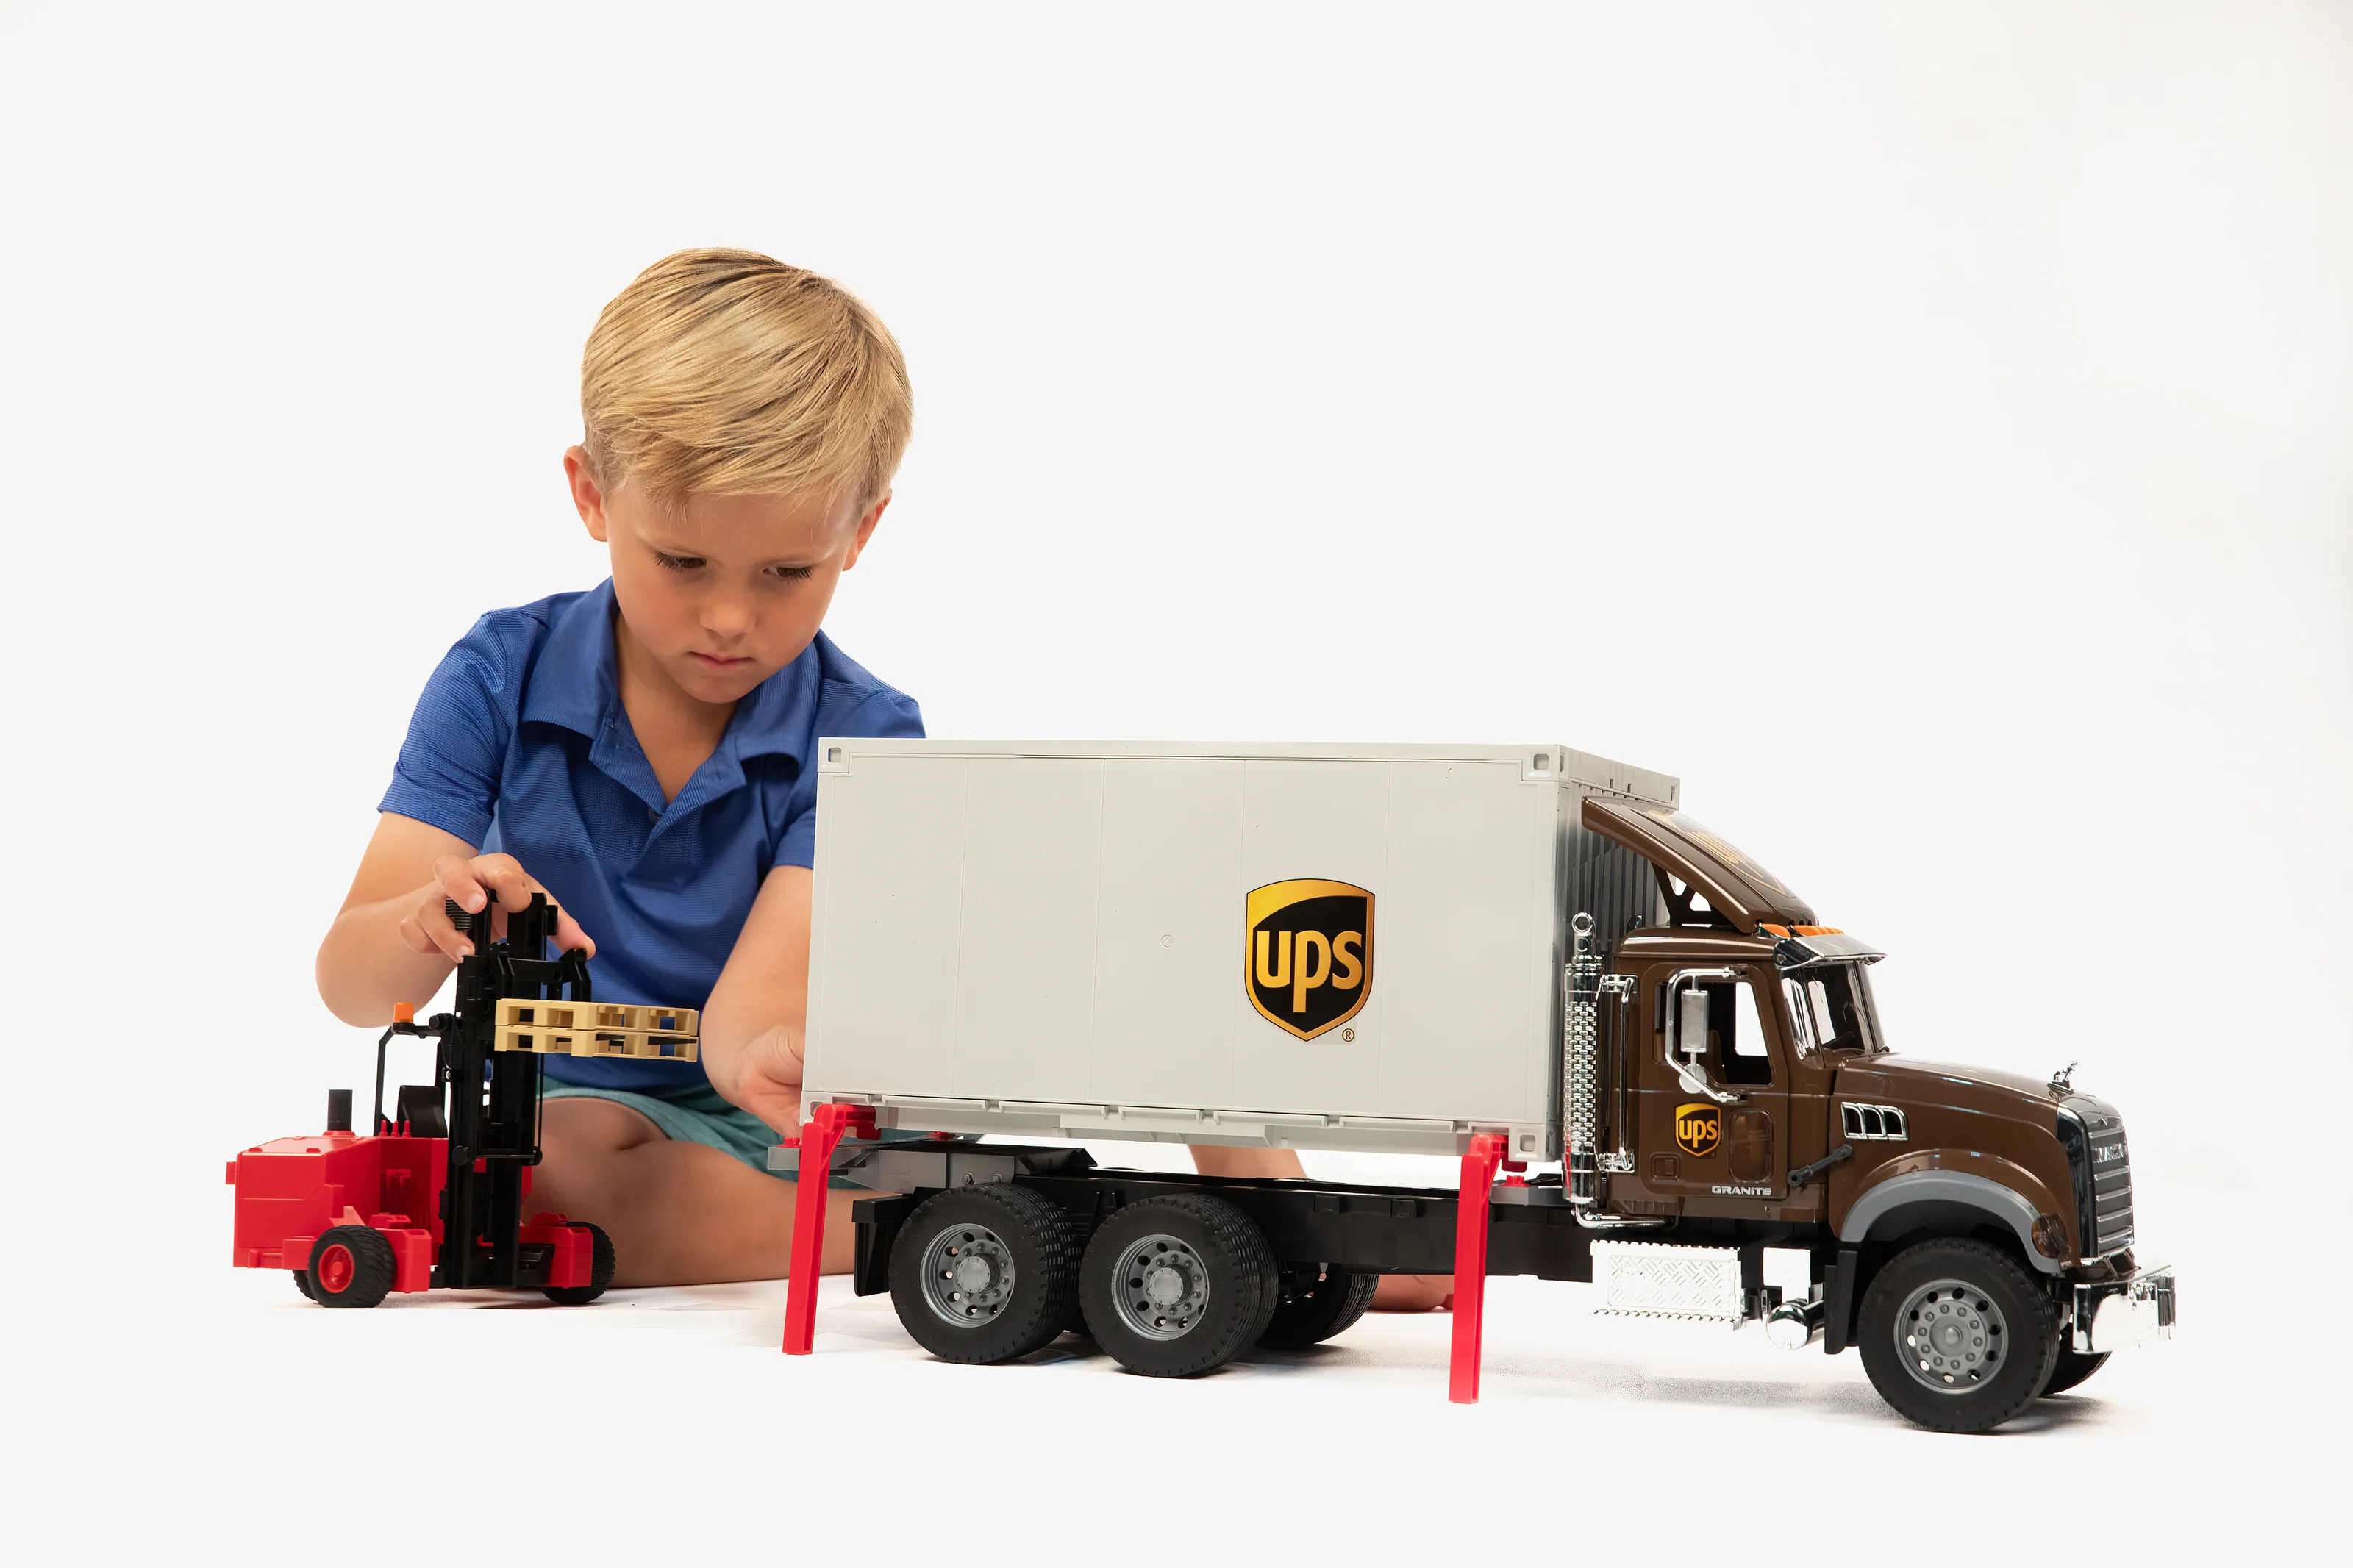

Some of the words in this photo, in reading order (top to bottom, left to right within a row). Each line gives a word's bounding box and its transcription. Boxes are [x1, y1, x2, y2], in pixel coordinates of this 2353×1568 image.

[1256, 930, 1363, 1013] ups
[1679, 1120, 1718, 1148] ups
[1711, 1185, 1772, 1196] GRANITE
